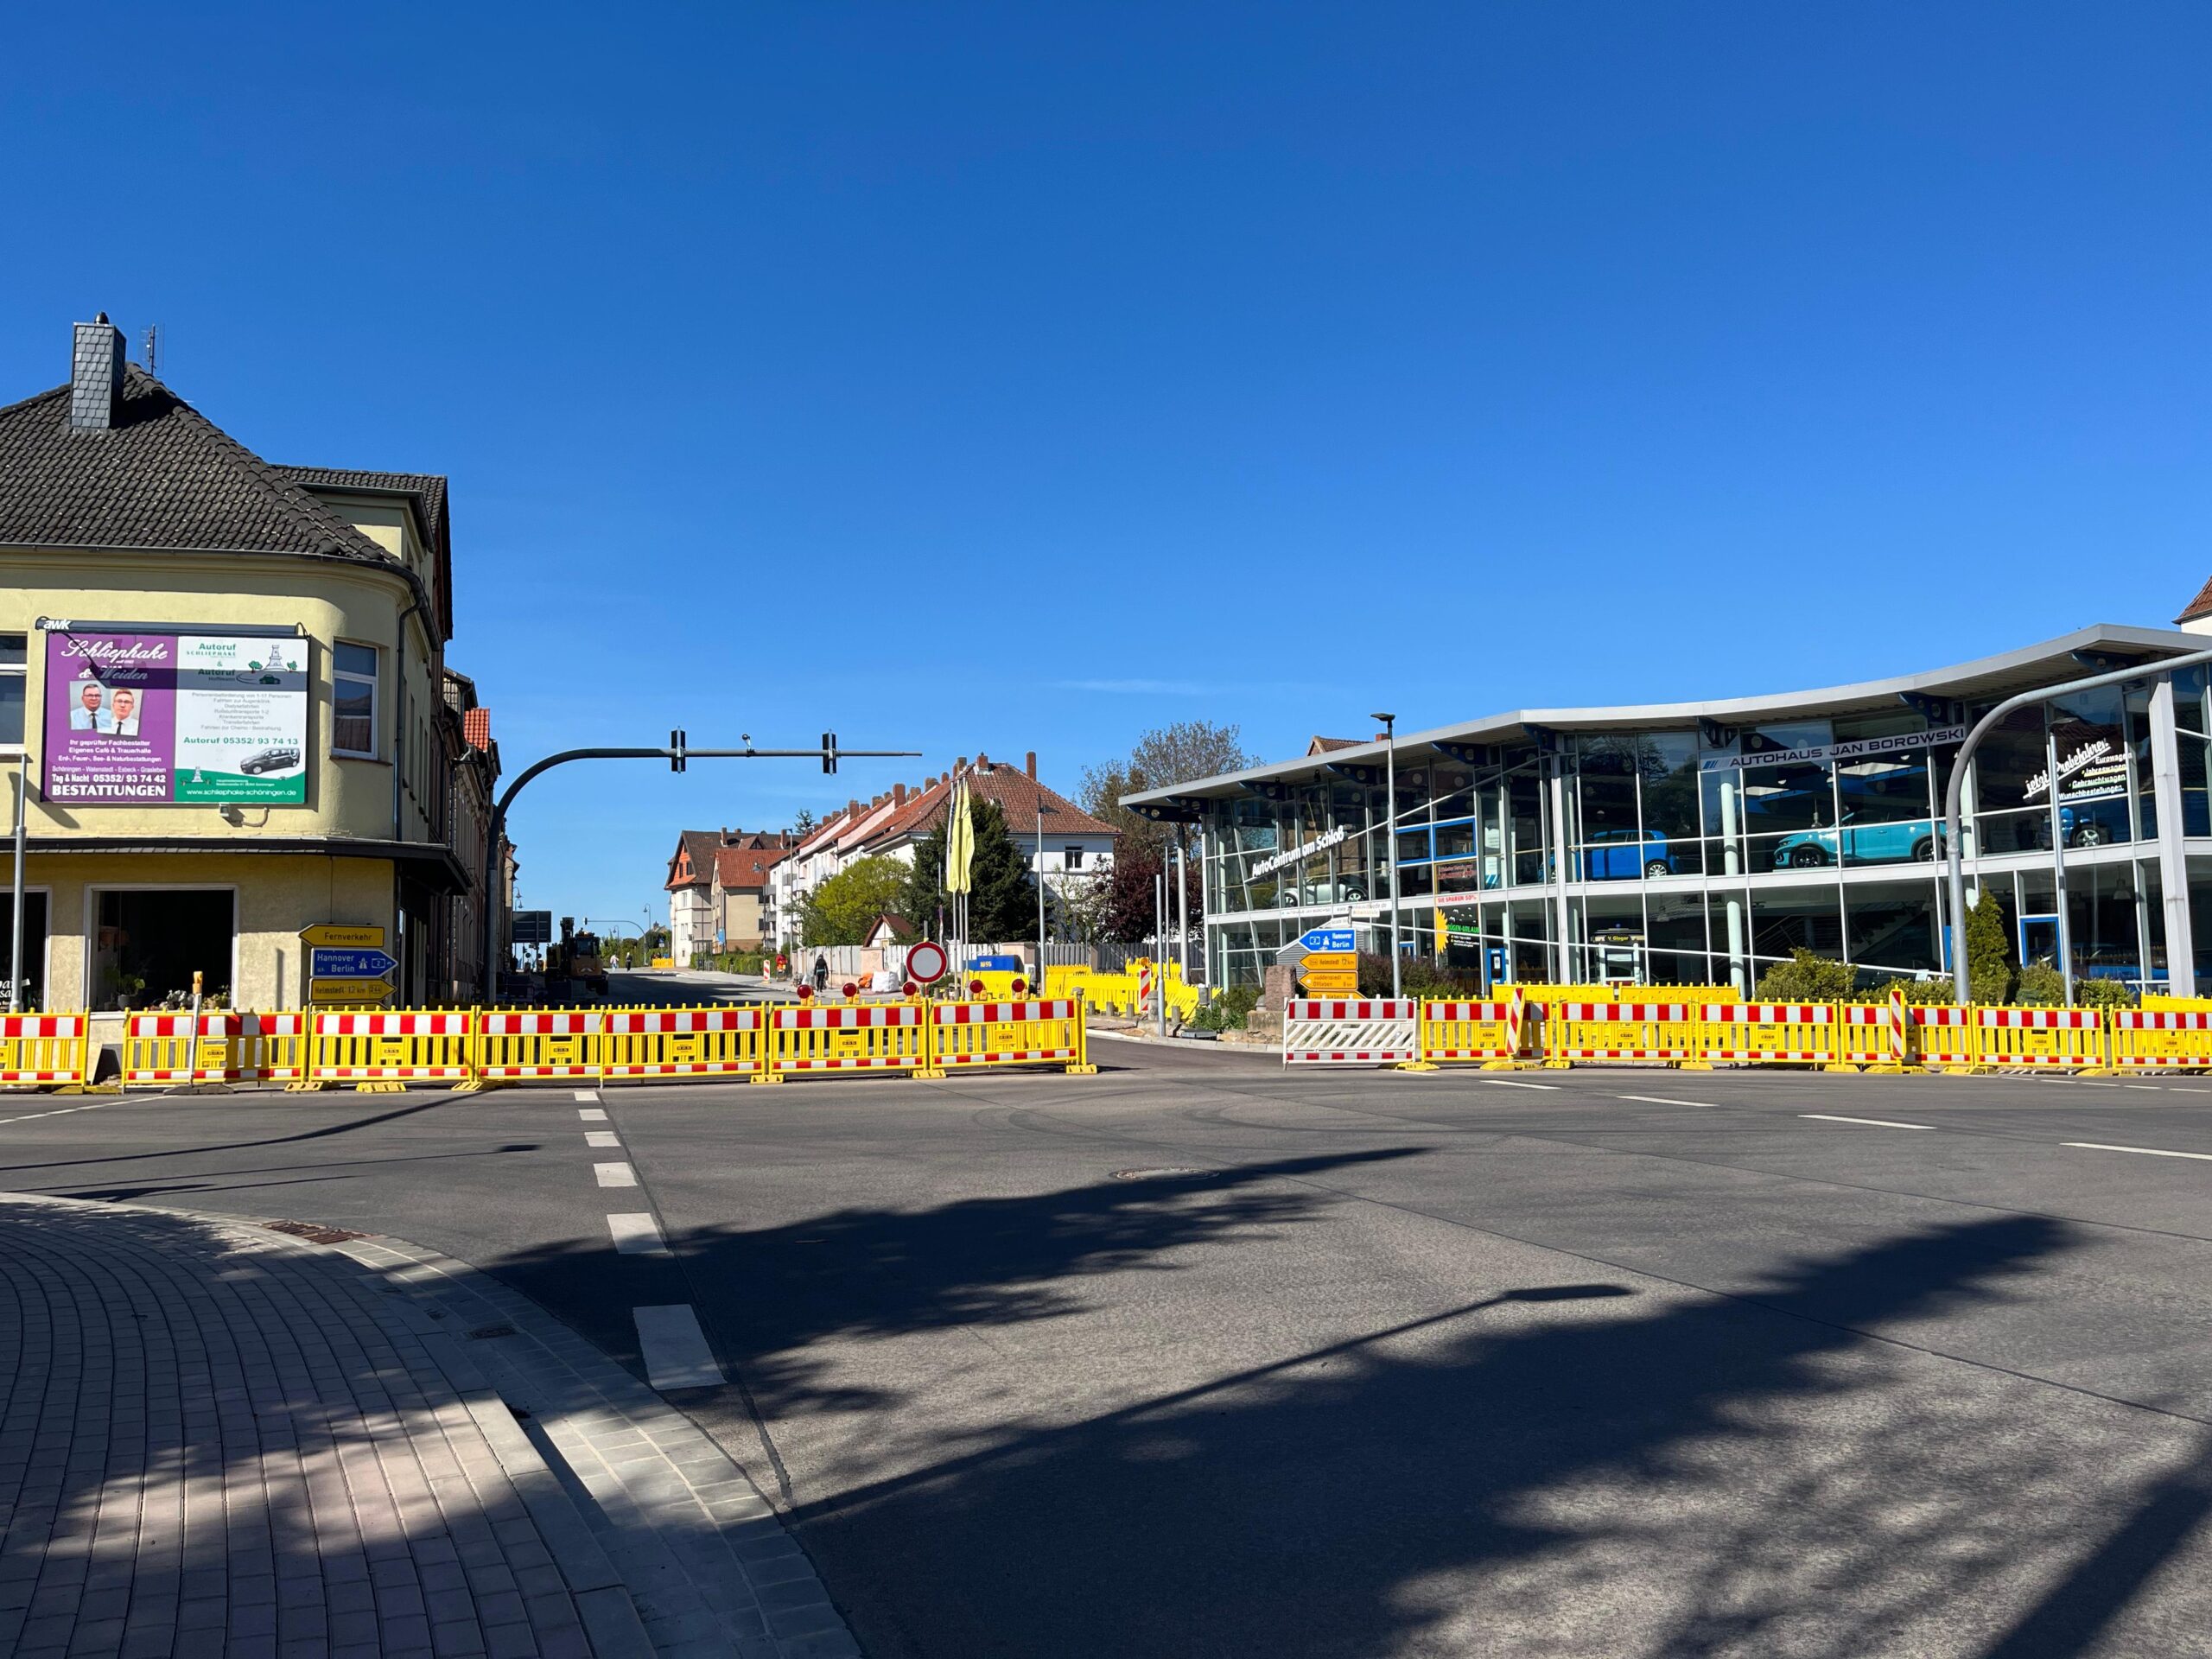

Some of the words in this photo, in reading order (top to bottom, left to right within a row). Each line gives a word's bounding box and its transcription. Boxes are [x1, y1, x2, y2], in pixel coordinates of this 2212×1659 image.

[44, 619, 71, 630] awk
[60, 639, 168, 664] Schliephake
[79, 668, 92, 678] &
[99, 667, 149, 680] Weiden
[1729, 747, 1823, 767] AUTOHAUS
[1829, 743, 1864, 757] JAN
[1868, 728, 1964, 750] BOROWSKI
[52, 774, 63, 784] Tag
[92, 774, 124, 783] 05352/
[2071, 774, 2126, 789] Gebrauchtwagen
[52, 785, 166, 796] BESTATTUNGEN
[1252, 847, 1301, 877] AutoCentrum
[1301, 842, 1315, 857] am
[1316, 824, 1344, 850] Schloß
[317, 953, 355, 962] Hannover
